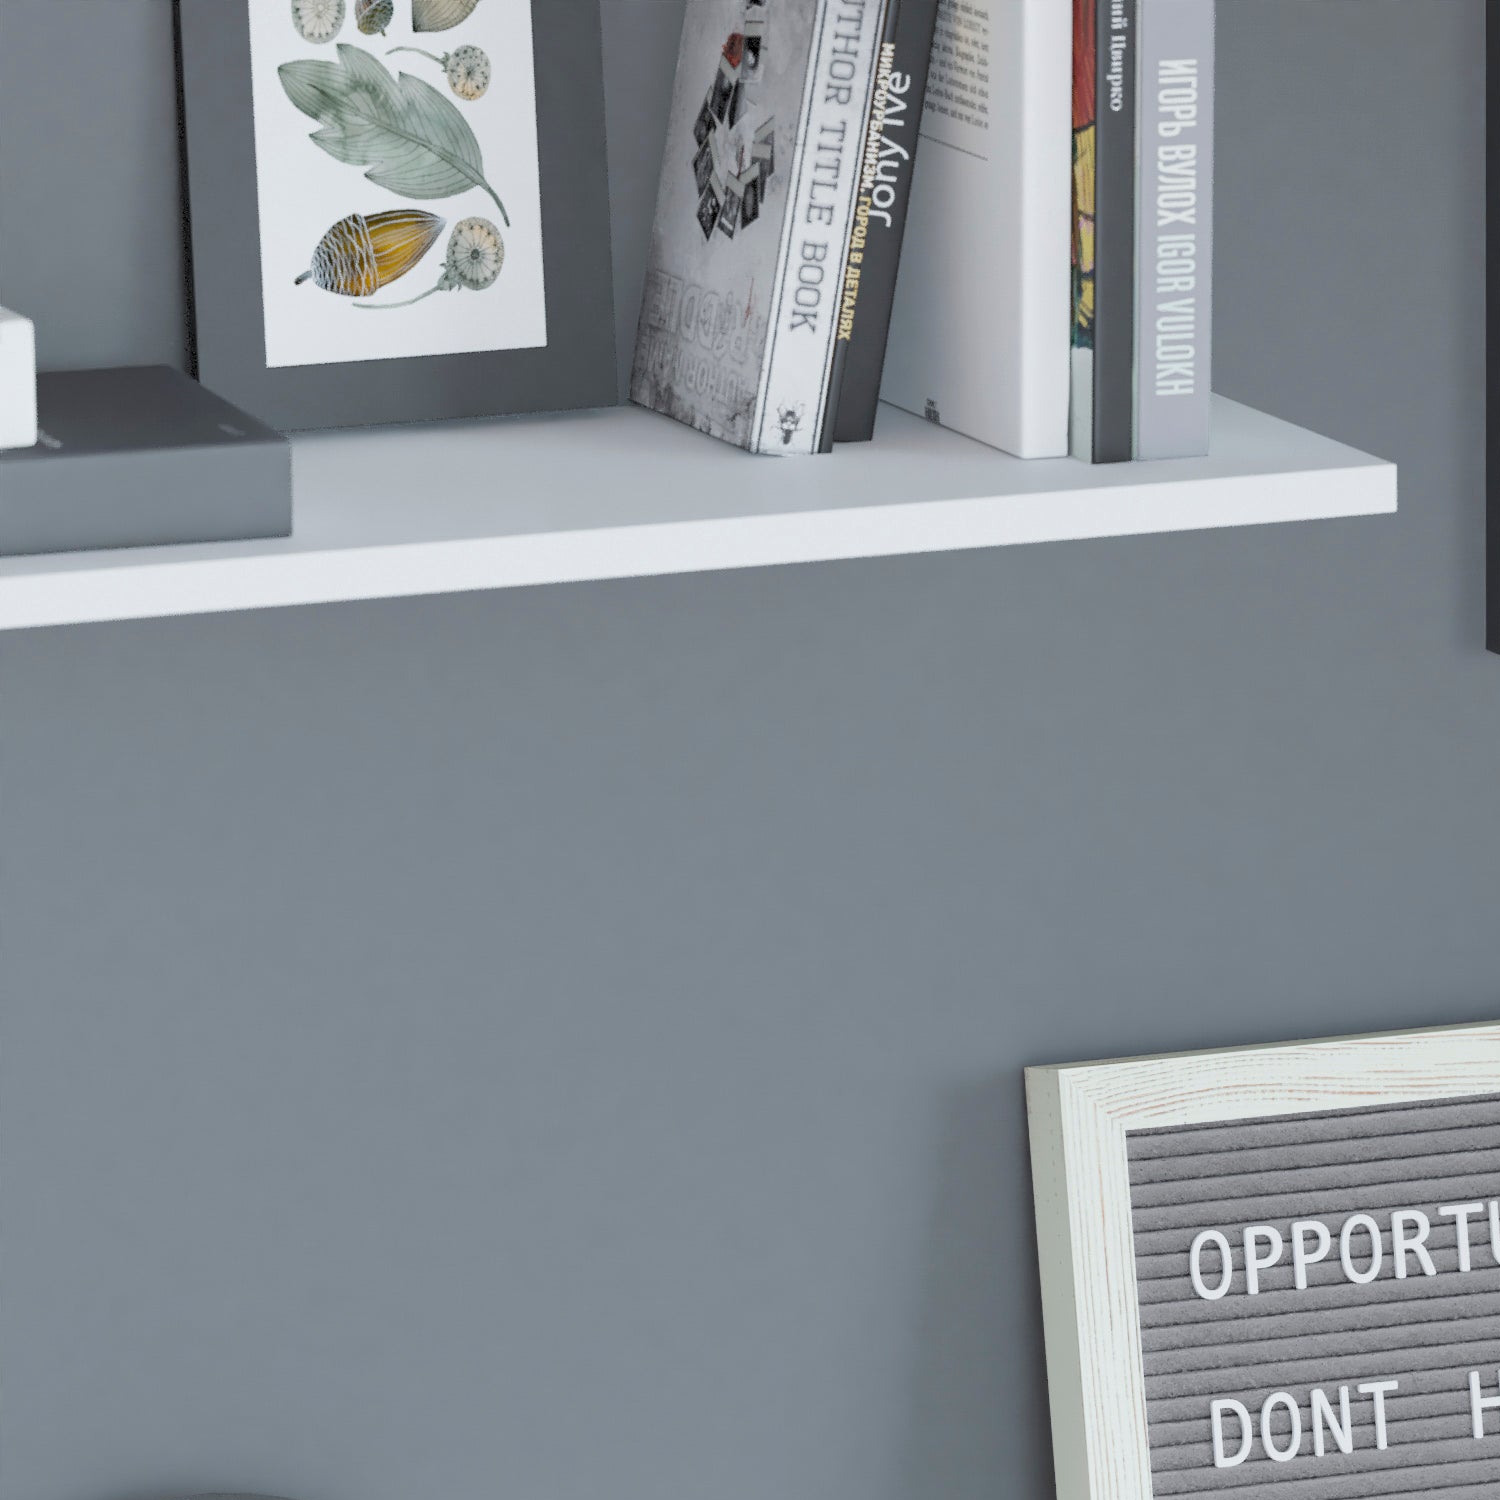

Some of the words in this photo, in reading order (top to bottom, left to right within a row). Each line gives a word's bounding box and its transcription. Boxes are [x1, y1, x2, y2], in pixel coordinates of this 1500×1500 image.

[859, 42, 896, 193] МИКРОУРБАНИЗМ.
[1157, 59, 1198, 137] ИГОРЬ
[806, 120, 847, 226] TITLE
[868, 135, 910, 228] Jony
[1156, 144, 1197, 227] ВУЛОХ
[849, 195, 872, 249] ГОРОД
[849, 251, 864, 264] В
[1155, 233, 1197, 294] IGOR
[790, 240, 829, 334] BOOK
[837, 265, 861, 341] ДЕТАЛЯХ
[1154, 297, 1196, 397] VULOKH
[1209, 1379, 1400, 1469] DONT
